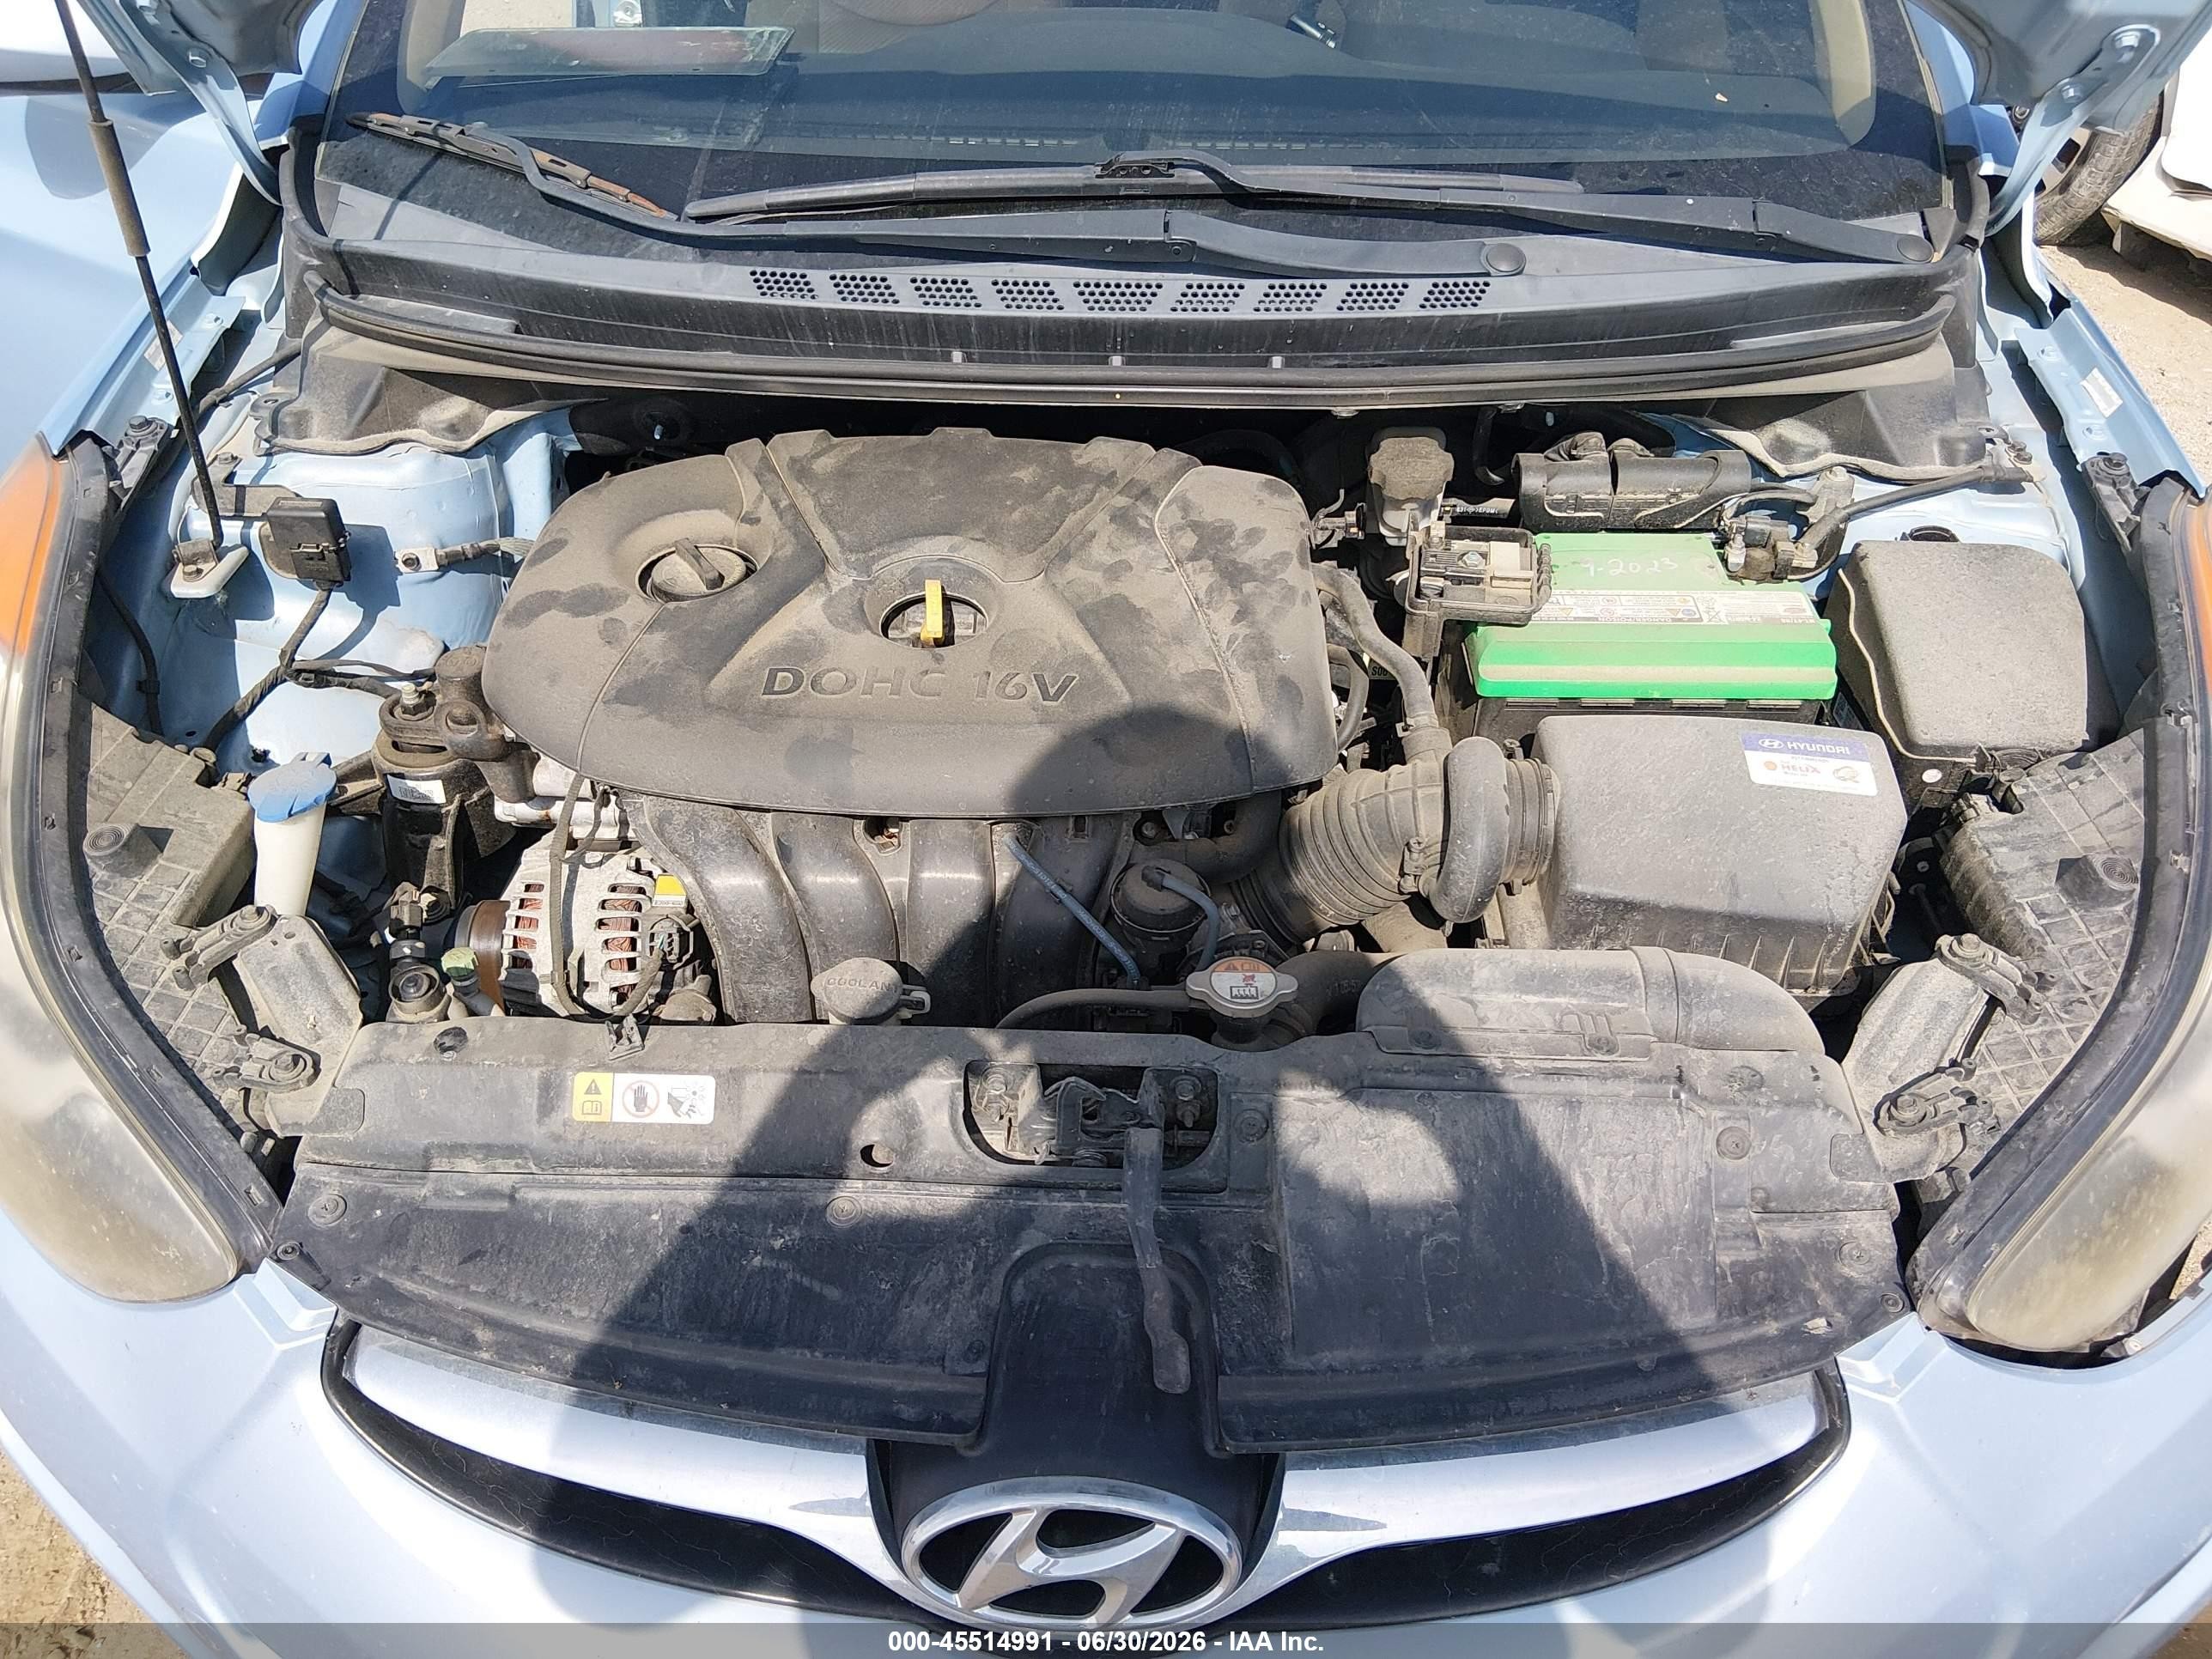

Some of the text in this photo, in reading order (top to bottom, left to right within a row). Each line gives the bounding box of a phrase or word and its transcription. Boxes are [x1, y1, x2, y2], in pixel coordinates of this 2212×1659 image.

[761, 666, 1078, 702] DOHC 16V
[1786, 740, 1850, 756] HYUNDAI
